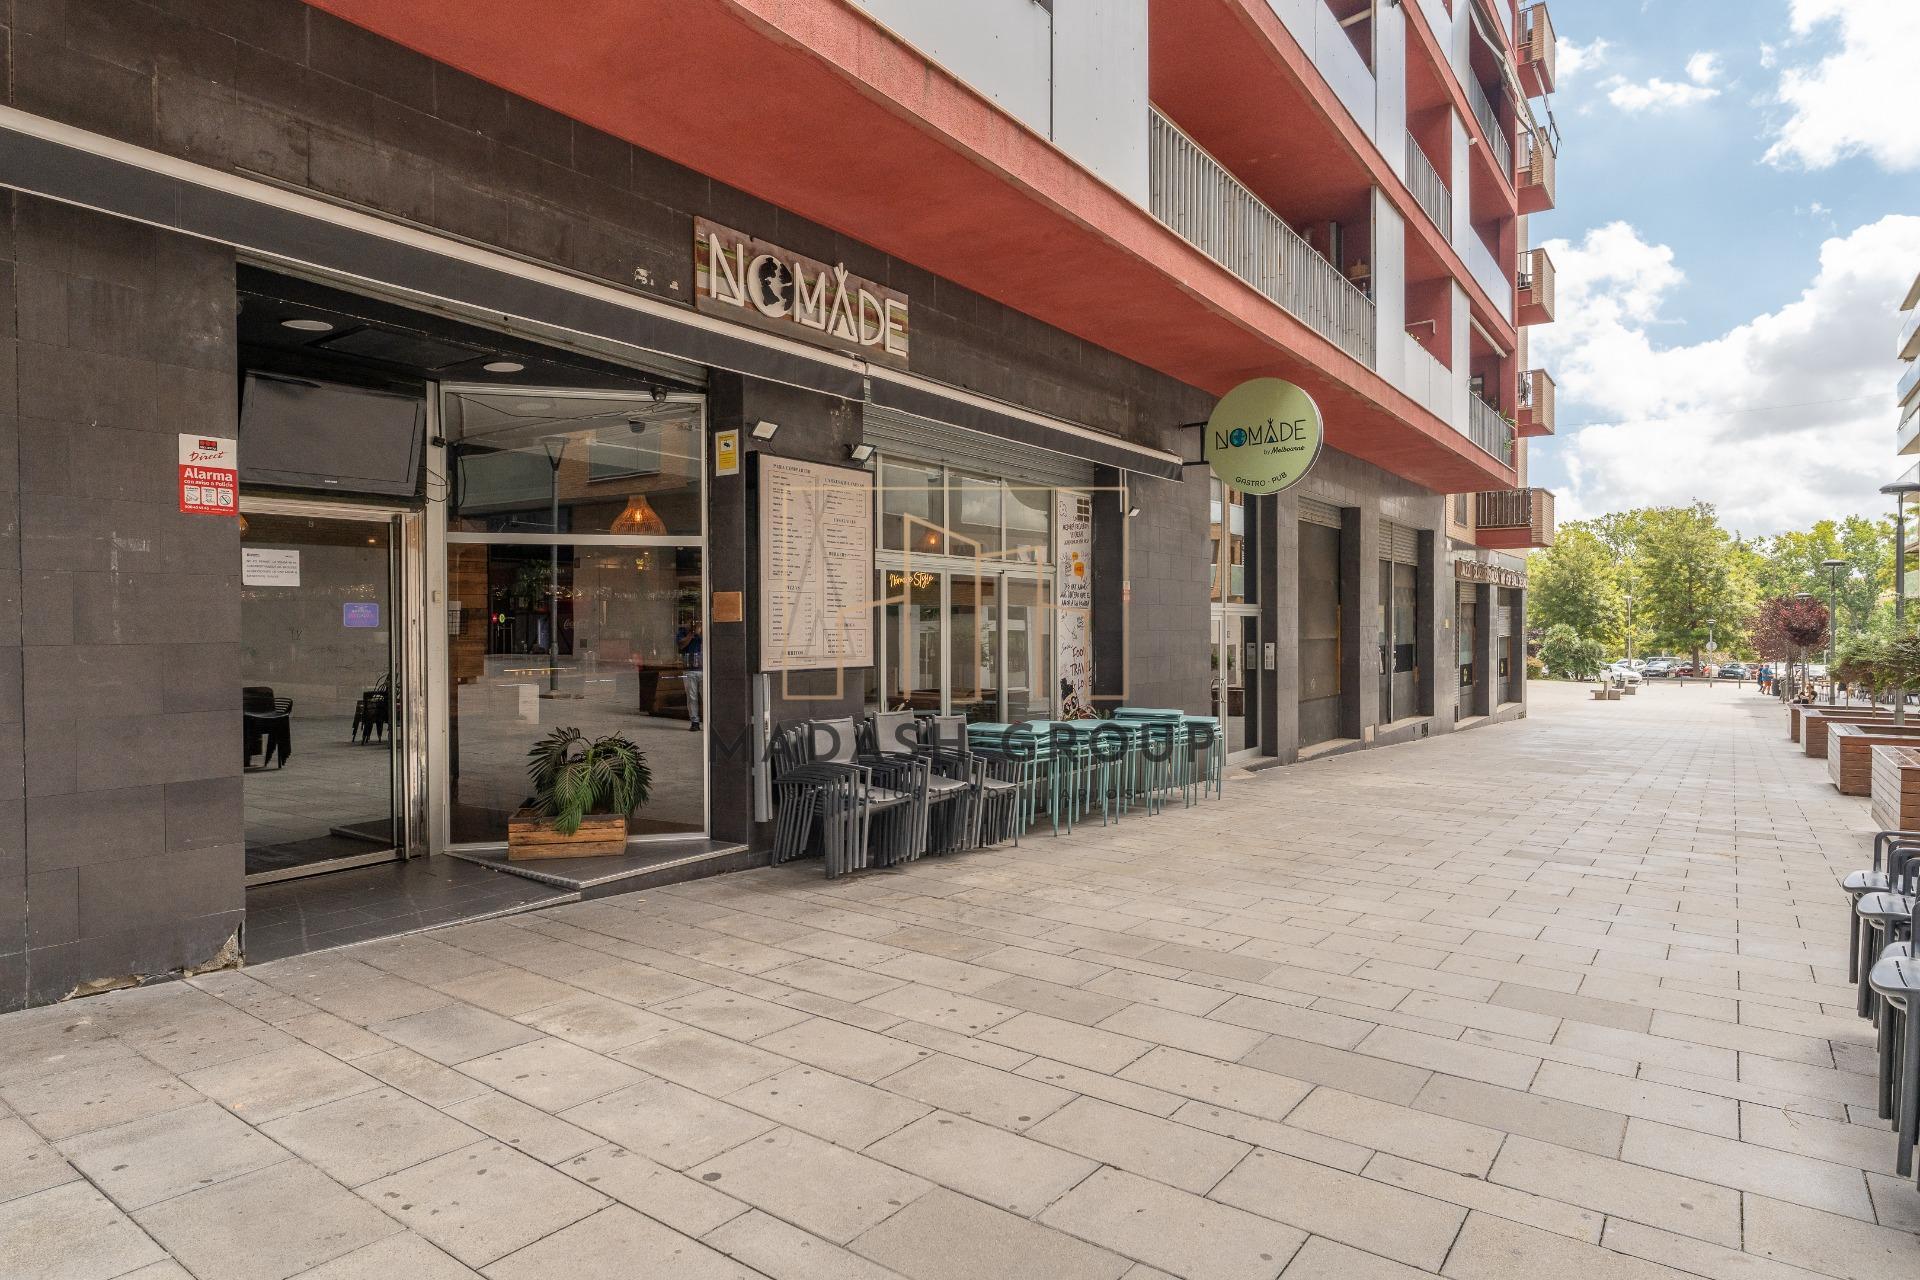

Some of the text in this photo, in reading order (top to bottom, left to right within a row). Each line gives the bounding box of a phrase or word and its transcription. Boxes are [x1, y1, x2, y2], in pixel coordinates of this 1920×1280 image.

[709, 231, 908, 358] NOMADE
[1215, 417, 1307, 451] NOMADE
[189, 451, 224, 461] Direct
[1271, 445, 1306, 454] Melbourne
[184, 467, 233, 481] Alarma
[1235, 471, 1288, 487] GASTRO PUB
